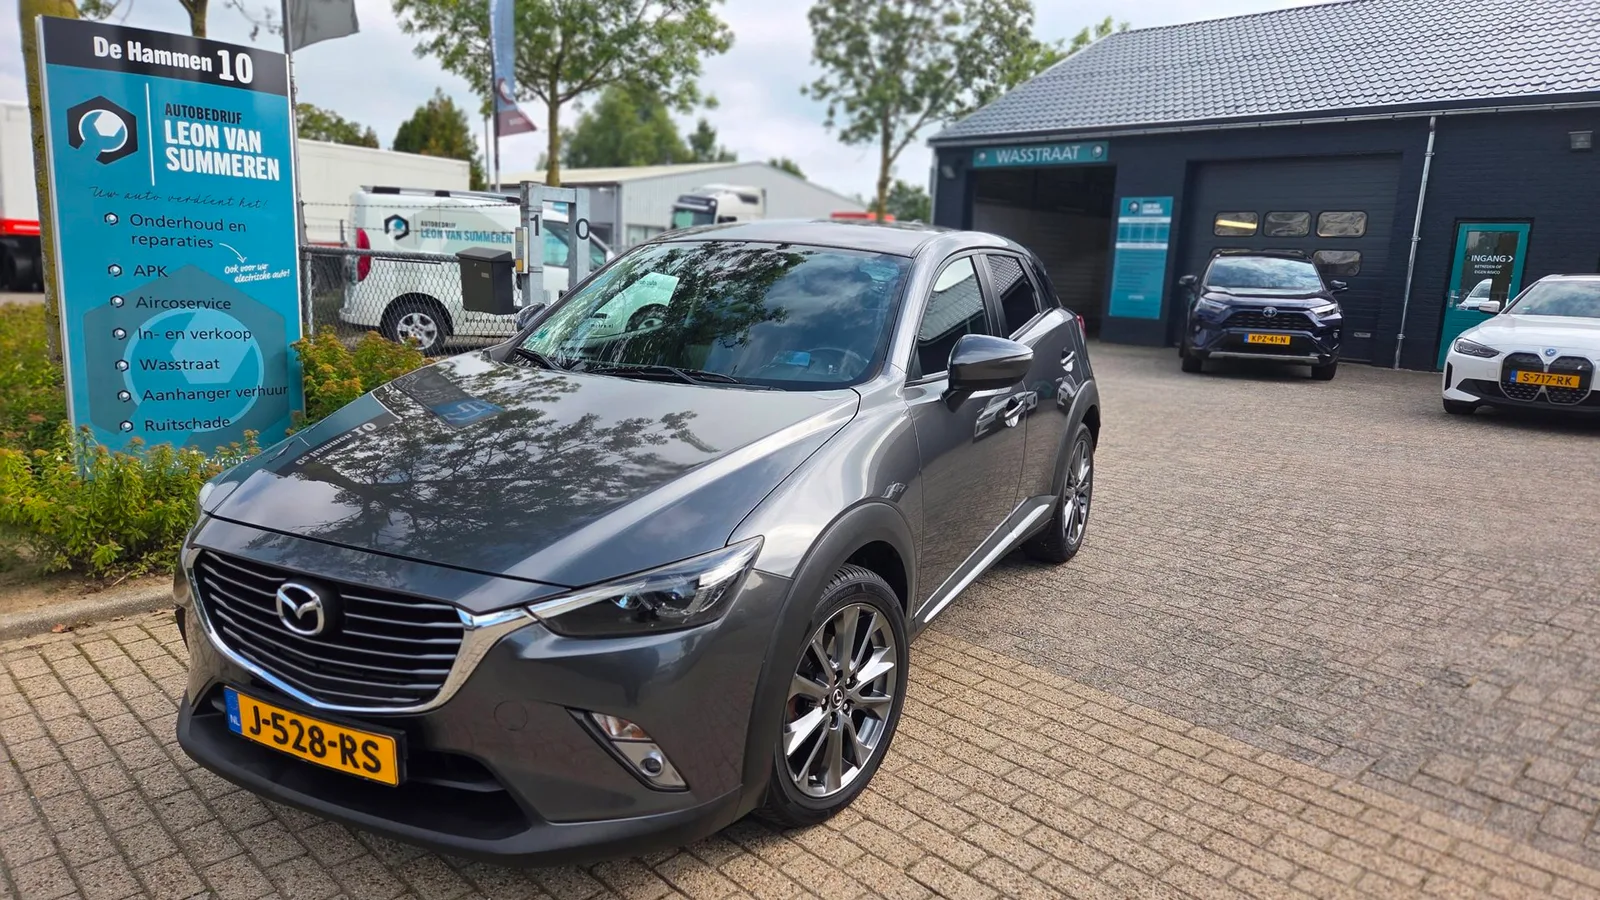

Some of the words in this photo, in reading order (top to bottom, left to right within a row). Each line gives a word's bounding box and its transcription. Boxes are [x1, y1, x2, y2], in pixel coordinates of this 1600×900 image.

[93, 36, 122, 59] De
[127, 40, 212, 72] Hammen
[217, 50, 253, 84] 10
[165, 102, 243, 125] AUTOBEDRIJF
[164, 120, 219, 149] LEON
[224, 127, 262, 154] VAN
[996, 146, 1080, 164] WASSTRAAT
[166, 149, 280, 181] SUMMEREN
[89, 186, 119, 198] Uw
[124, 191, 162, 201] auto
[168, 194, 234, 207] verdient
[239, 198, 268, 209] het!
[129, 213, 223, 231] Onderhoud
[228, 222, 246, 232] en
[421, 220, 456, 228] AUTOBEDRIJF
[131, 234, 214, 249] reparaties
[420, 228, 443, 239] LEON
[445, 230, 462, 240] VAN
[463, 230, 512, 244] SUMMEREN
[133, 265, 169, 277] APK
[224, 264, 239, 274] Ook
[234, 270, 271, 283] electrische
[136, 297, 231, 310] Aircoservice
[138, 329, 160, 340] In-
[165, 329, 185, 340] en
[190, 327, 252, 343] verkoop
[1251, 335, 1287, 343] KPZ-41-N
[139, 358, 220, 371] Wasstraat
[1523, 373, 1572, 385] S-717-RK
[142, 388, 231, 402] Aanhanger
[235, 385, 289, 398] verhuur
[145, 416, 231, 432] Ruitschade
[230, 714, 240, 726] NL
[249, 705, 382, 773] J-528-RS
